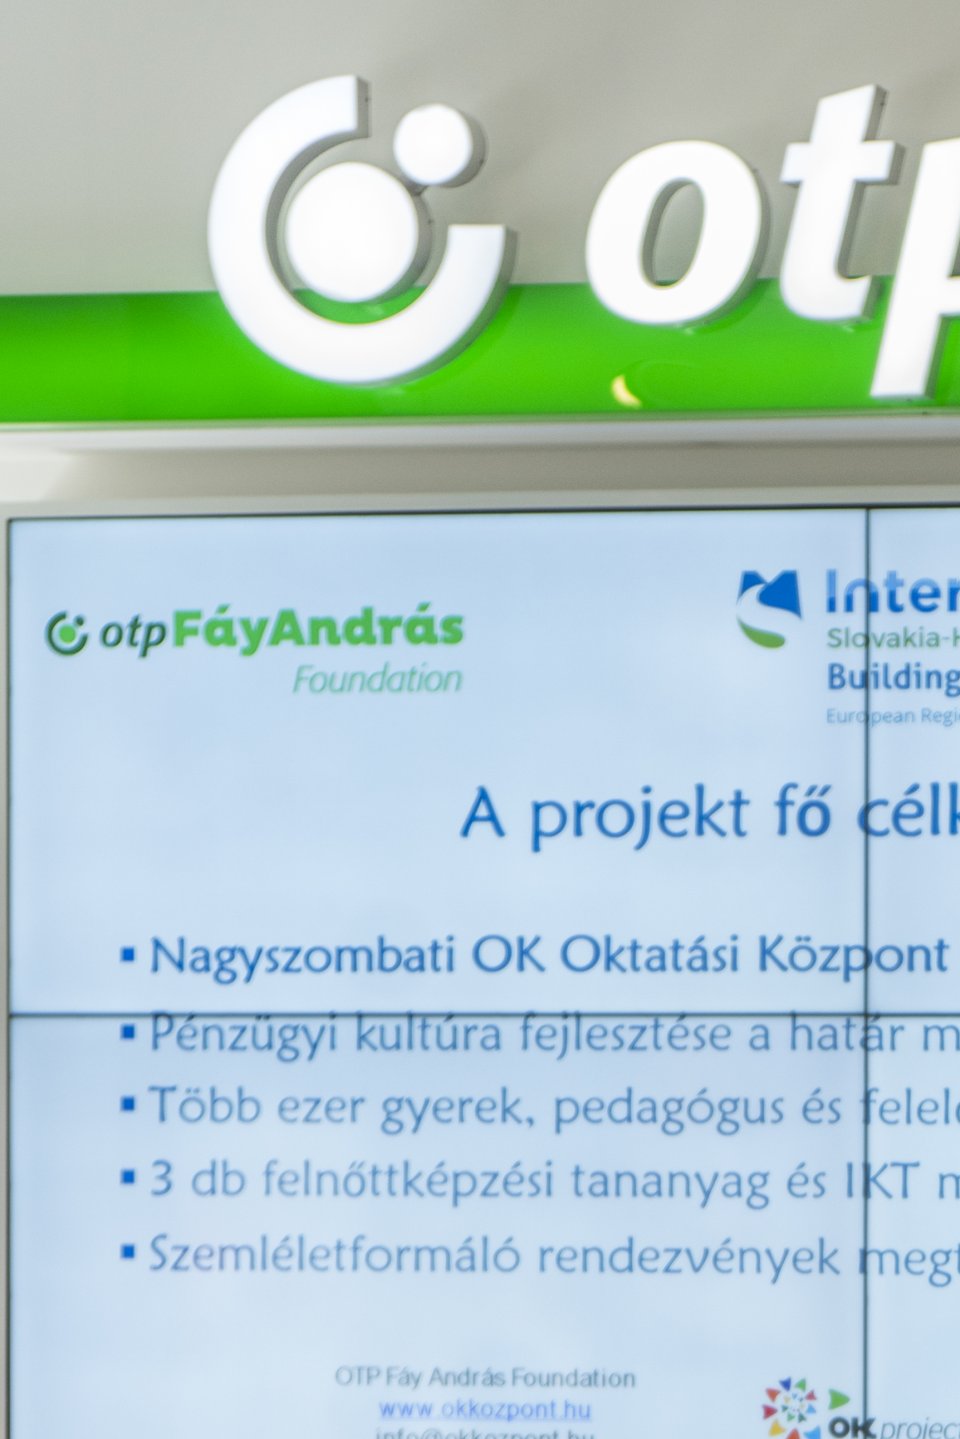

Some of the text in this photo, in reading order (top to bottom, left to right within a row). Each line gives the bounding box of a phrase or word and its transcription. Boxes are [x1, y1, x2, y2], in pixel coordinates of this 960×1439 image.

[292, 661, 463, 694] Foundation
[826, 706, 916, 726] European
[459, 785, 506, 839] A
[530, 782, 751, 854] projekt
[774, 782, 833, 837] fő
[150, 935, 456, 985] Nagyszombati
[471, 934, 547, 974] OK
[560, 934, 740, 974] Oktatási
[758, 934, 949, 983] Központ
[150, 1011, 338, 1063] Pénzügyi
[355, 1011, 503, 1053] kultúra
[518, 1011, 733, 1061] fejlesztése
[748, 1023, 771, 1052] a
[790, 1011, 905, 1053] határ
[148, 1085, 262, 1124] Több
[277, 1093, 365, 1124] ezer
[380, 1086, 536, 1136] gyerek,
[554, 1086, 785, 1137] pedagógus
[801, 1088, 843, 1126] és
[151, 1160, 174, 1198] 3
[190, 1160, 247, 1197] db
[263, 1160, 555, 1208] felnőttképzési
[572, 1164, 771, 1210] tananyag
[785, 1162, 827, 1199] és
[845, 1161, 921, 1200] IKT
[148, 1234, 522, 1274] Szemléletformáló
[538, 1236, 841, 1285] rendezvények
[335, 1365, 636, 1390] OTP Fáy András Foundation
